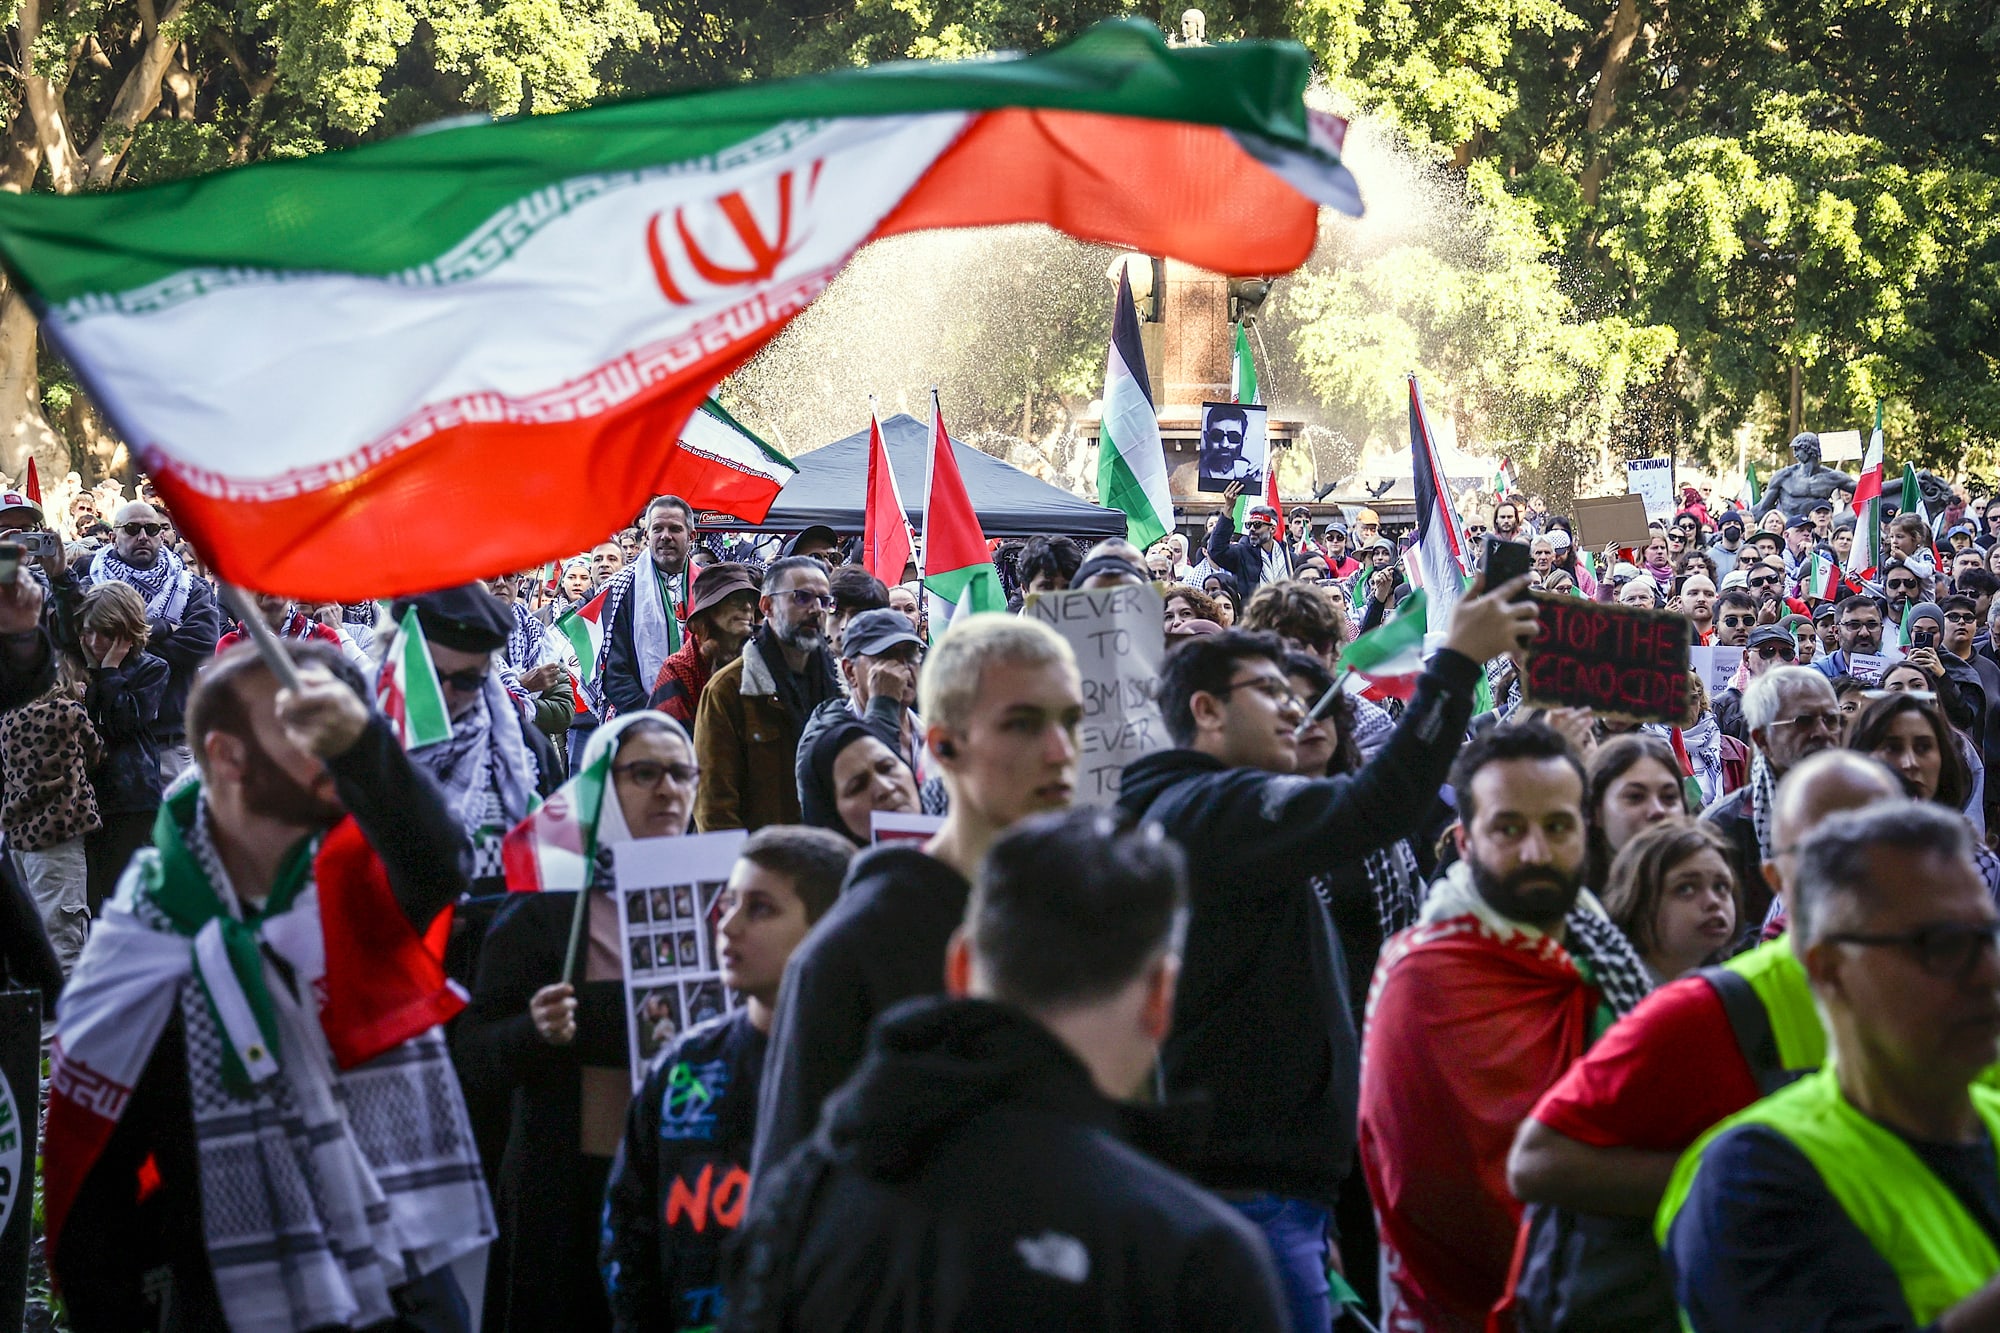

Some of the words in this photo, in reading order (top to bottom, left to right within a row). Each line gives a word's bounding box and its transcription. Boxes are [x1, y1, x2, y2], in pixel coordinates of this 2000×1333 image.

[1628, 458, 1670, 471] NETANYAHU
[703, 513, 728, 521] Coleman
[1036, 586, 1143, 623] NEVER
[1087, 629, 1130, 659] TO
[1532, 604, 1609, 651] STOP
[1612, 615, 1679, 667] THE
[1529, 652, 1687, 716] GENOCIDE
[1083, 718, 1157, 753] EVER
